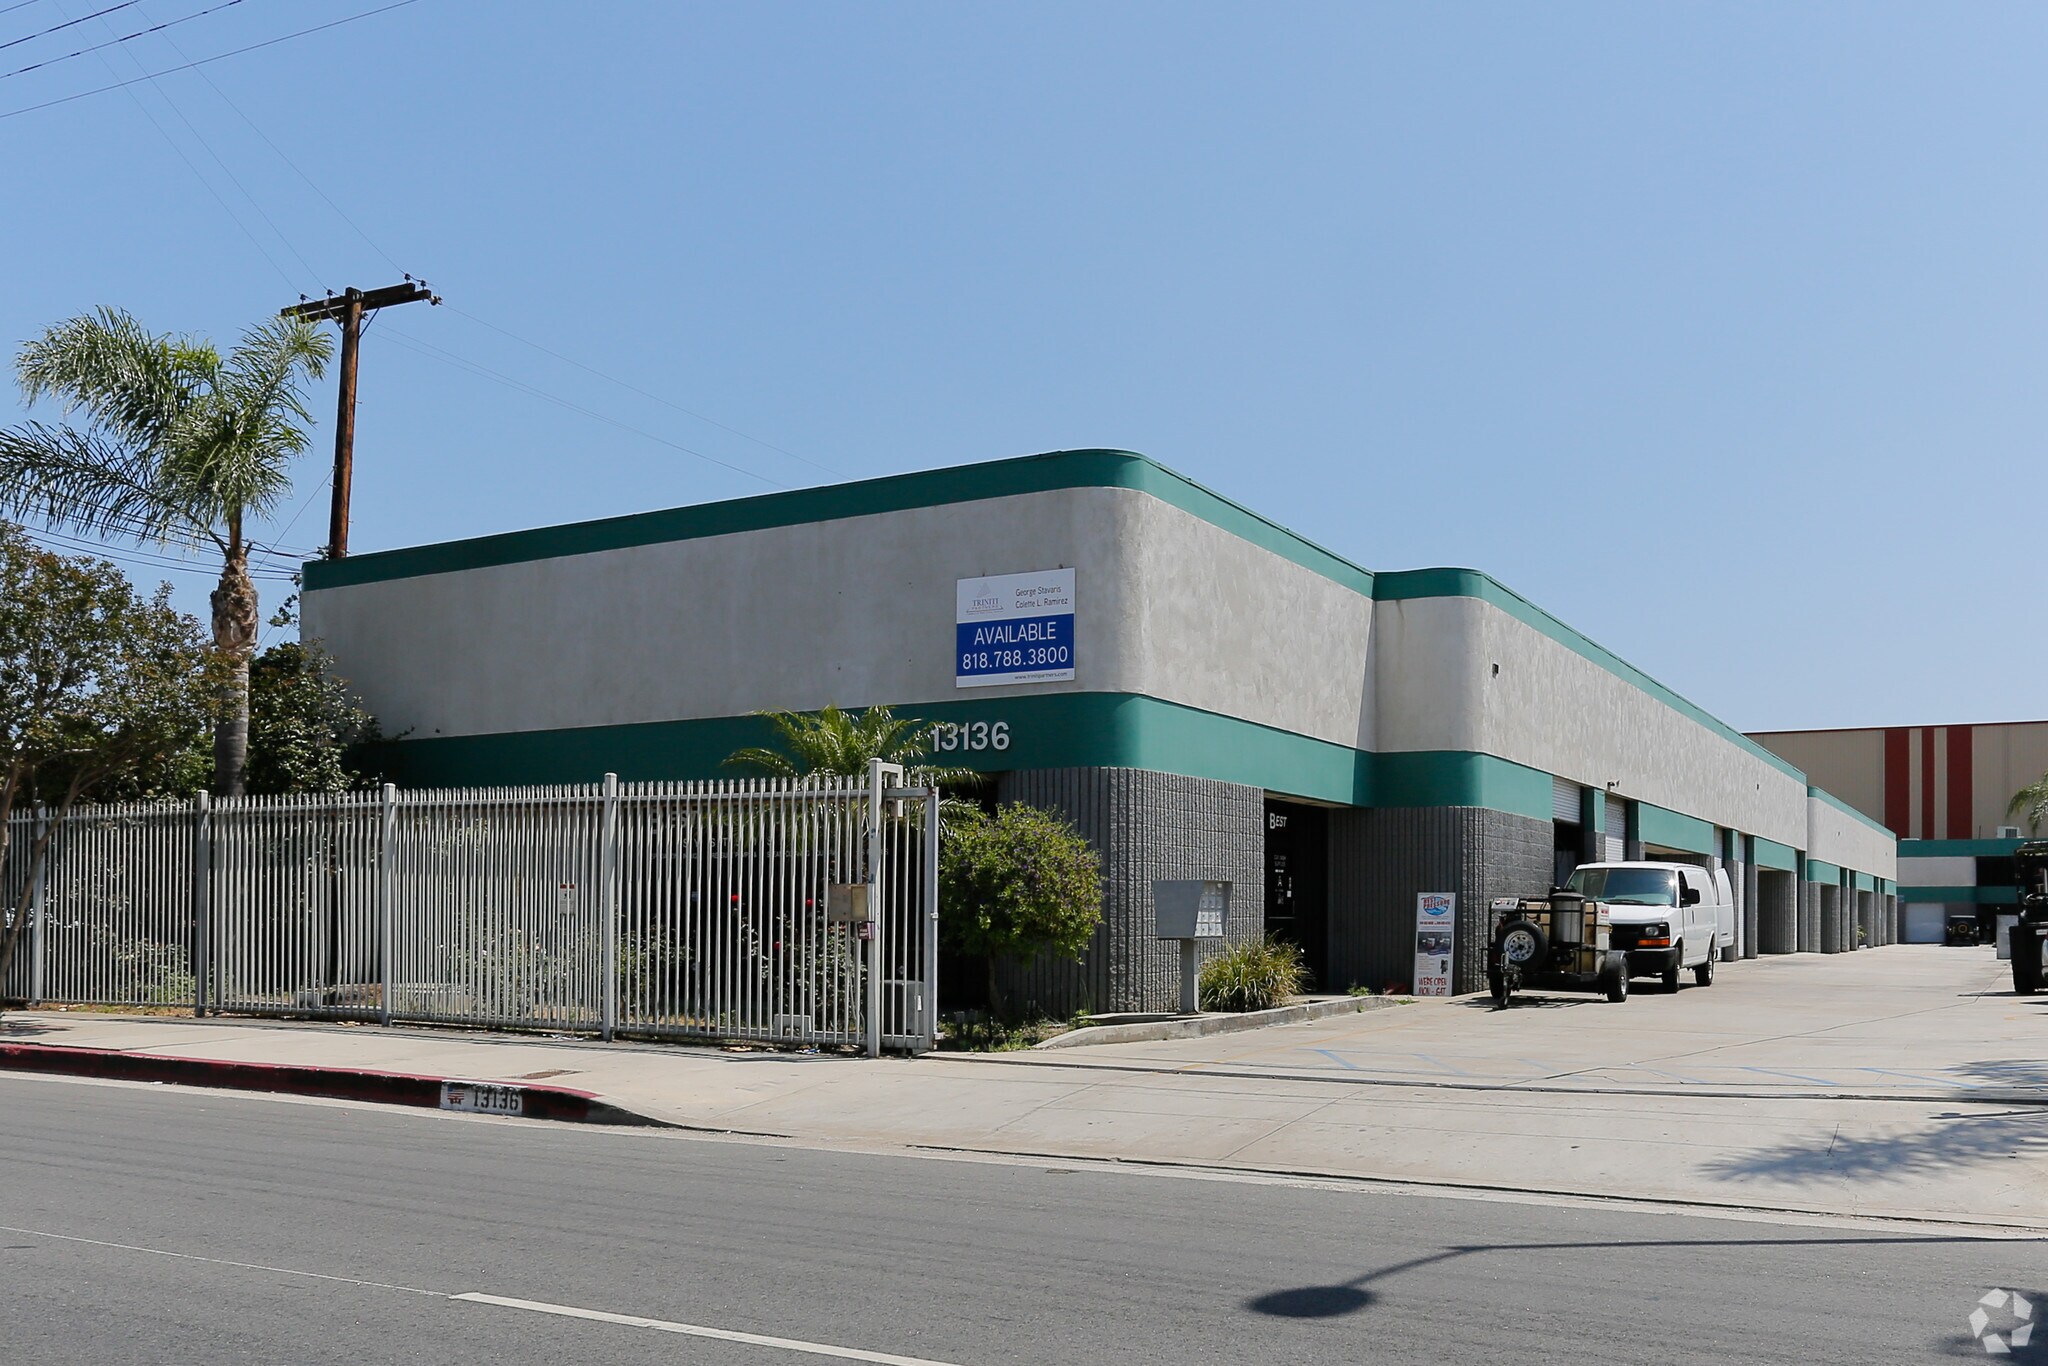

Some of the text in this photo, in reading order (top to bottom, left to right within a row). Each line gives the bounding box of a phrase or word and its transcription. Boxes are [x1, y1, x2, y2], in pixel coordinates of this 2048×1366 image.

[1015, 588, 1036, 598] George
[1043, 597, 1069, 607] Ramirez
[974, 622, 1056, 645] AVAILABLE
[962, 645, 1068, 670] 818.788.3800
[930, 721, 1010, 752] 13136
[473, 1088, 518, 1111] 13136
